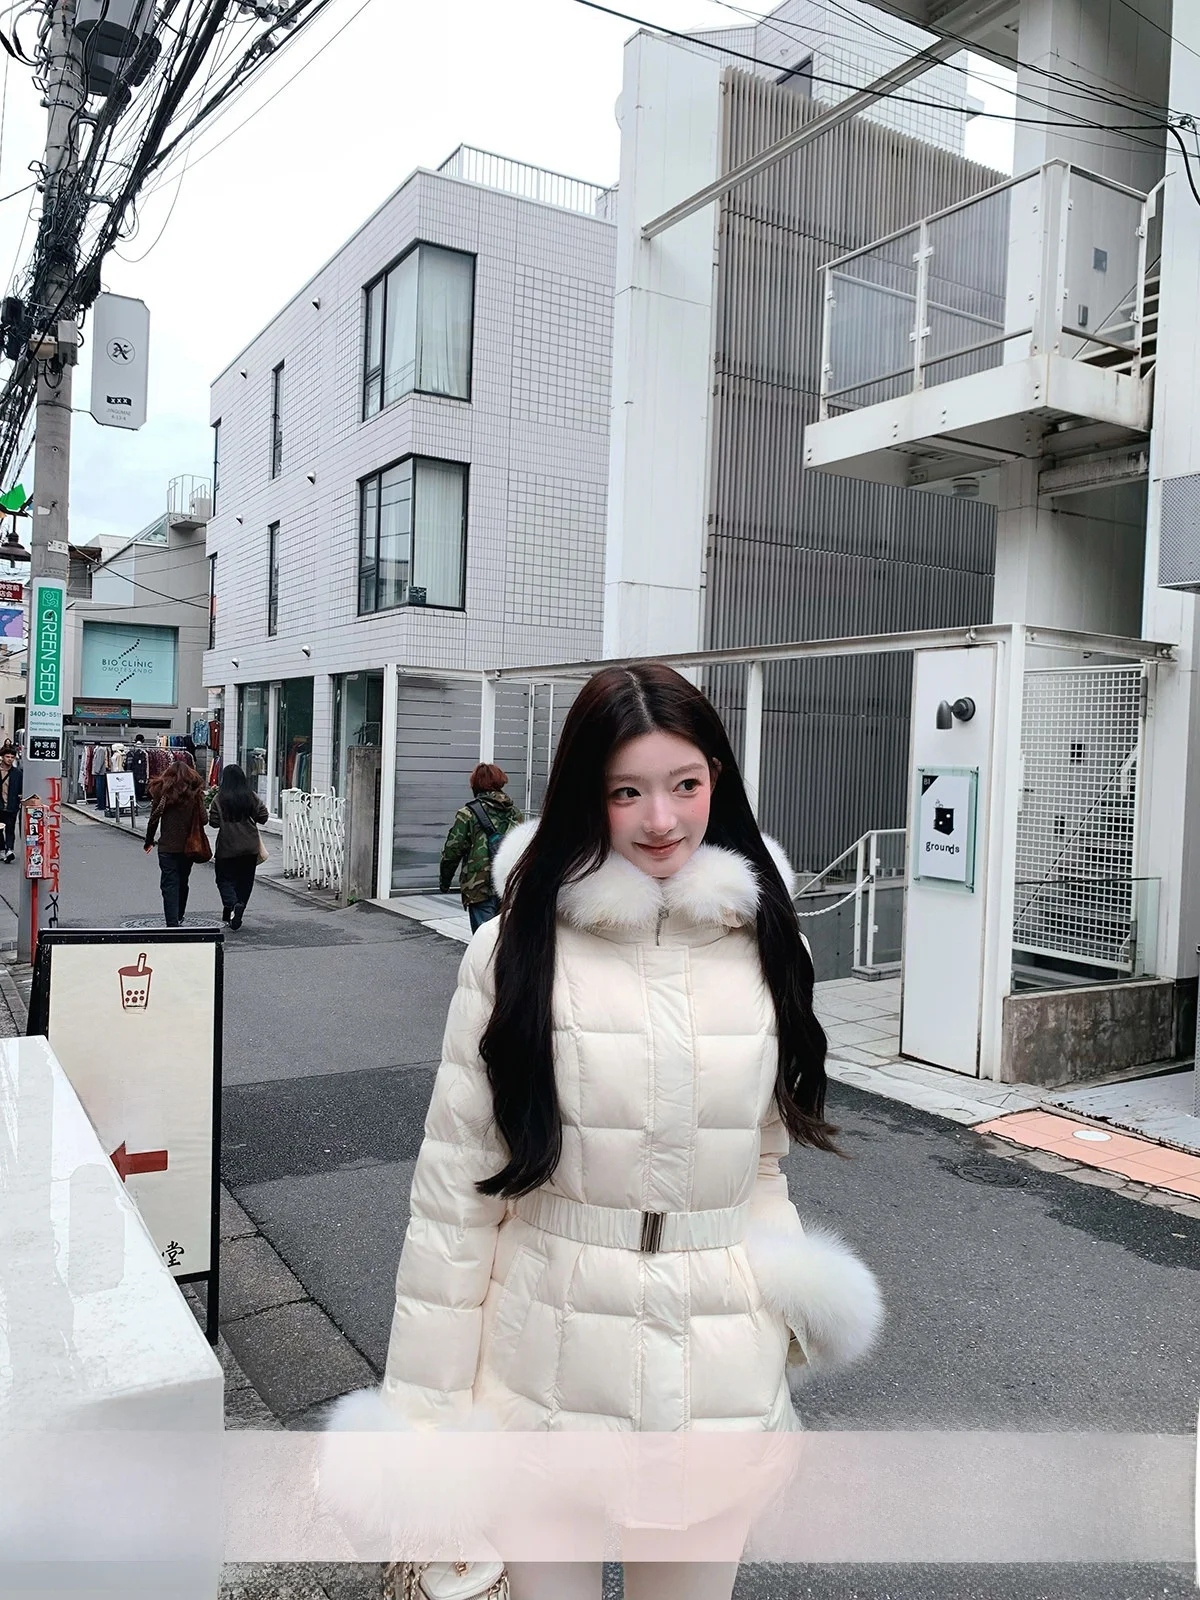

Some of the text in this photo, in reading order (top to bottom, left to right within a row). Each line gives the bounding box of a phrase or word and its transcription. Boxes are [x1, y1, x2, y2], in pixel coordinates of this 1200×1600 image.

[40, 609, 58, 702] GREEN SEED
[121, 660, 153, 668] CLINIC
[34, 741, 57, 749] 神宮前
[34, 750, 56, 758] 4-28
[925, 841, 960, 855] grounds
[161, 1240, 185, 1268] 堂
